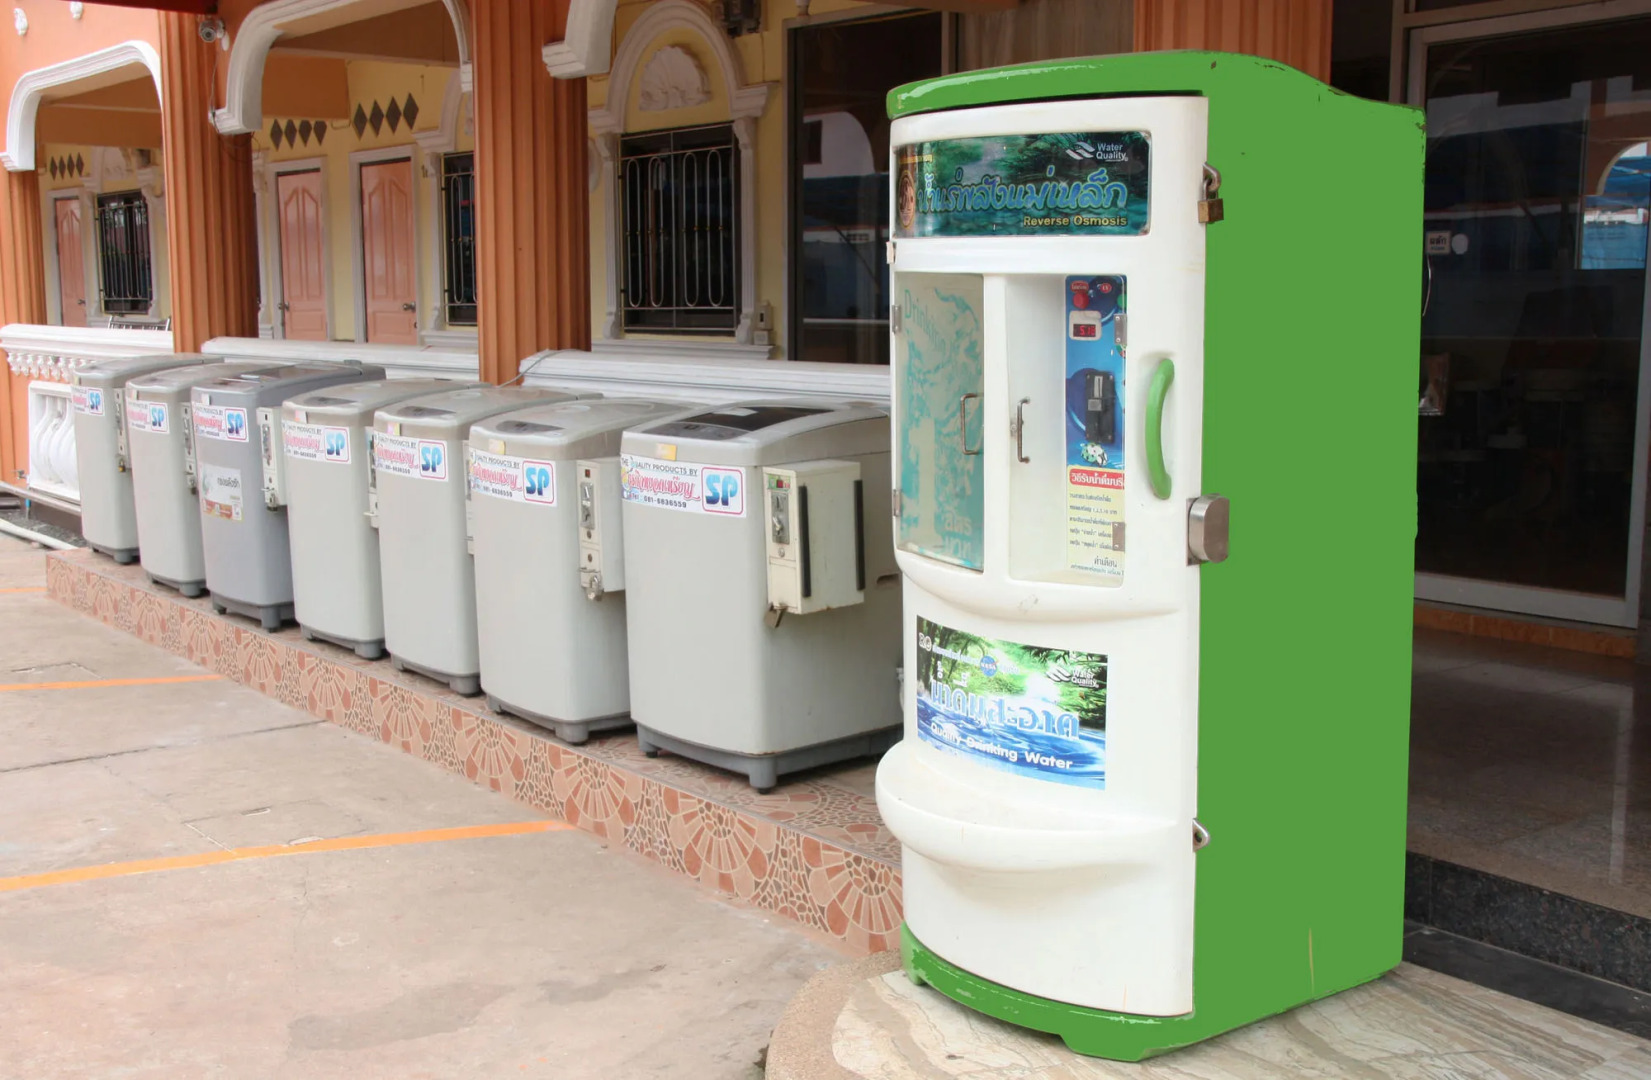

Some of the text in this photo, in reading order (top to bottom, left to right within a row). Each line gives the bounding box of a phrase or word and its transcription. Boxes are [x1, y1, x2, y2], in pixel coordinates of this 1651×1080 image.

[1096, 151, 1127, 161] Quality
[1098, 143, 1123, 152] Water
[1023, 215, 1127, 226] Reverse Osmosis
[90, 392, 101, 411] SP
[151, 407, 165, 427] SP
[227, 413, 243, 435] SP
[326, 433, 345, 456] SP
[421, 446, 443, 472] SP
[652, 463, 687, 475] PRODUCTS
[689, 467, 698, 476] BY
[525, 467, 550, 496] SP
[705, 474, 738, 506] SP
[1071, 676, 1098, 687] Quality
[1072, 668, 1096, 679] Water
[930, 721, 1074, 769] Quality Drinking Water
